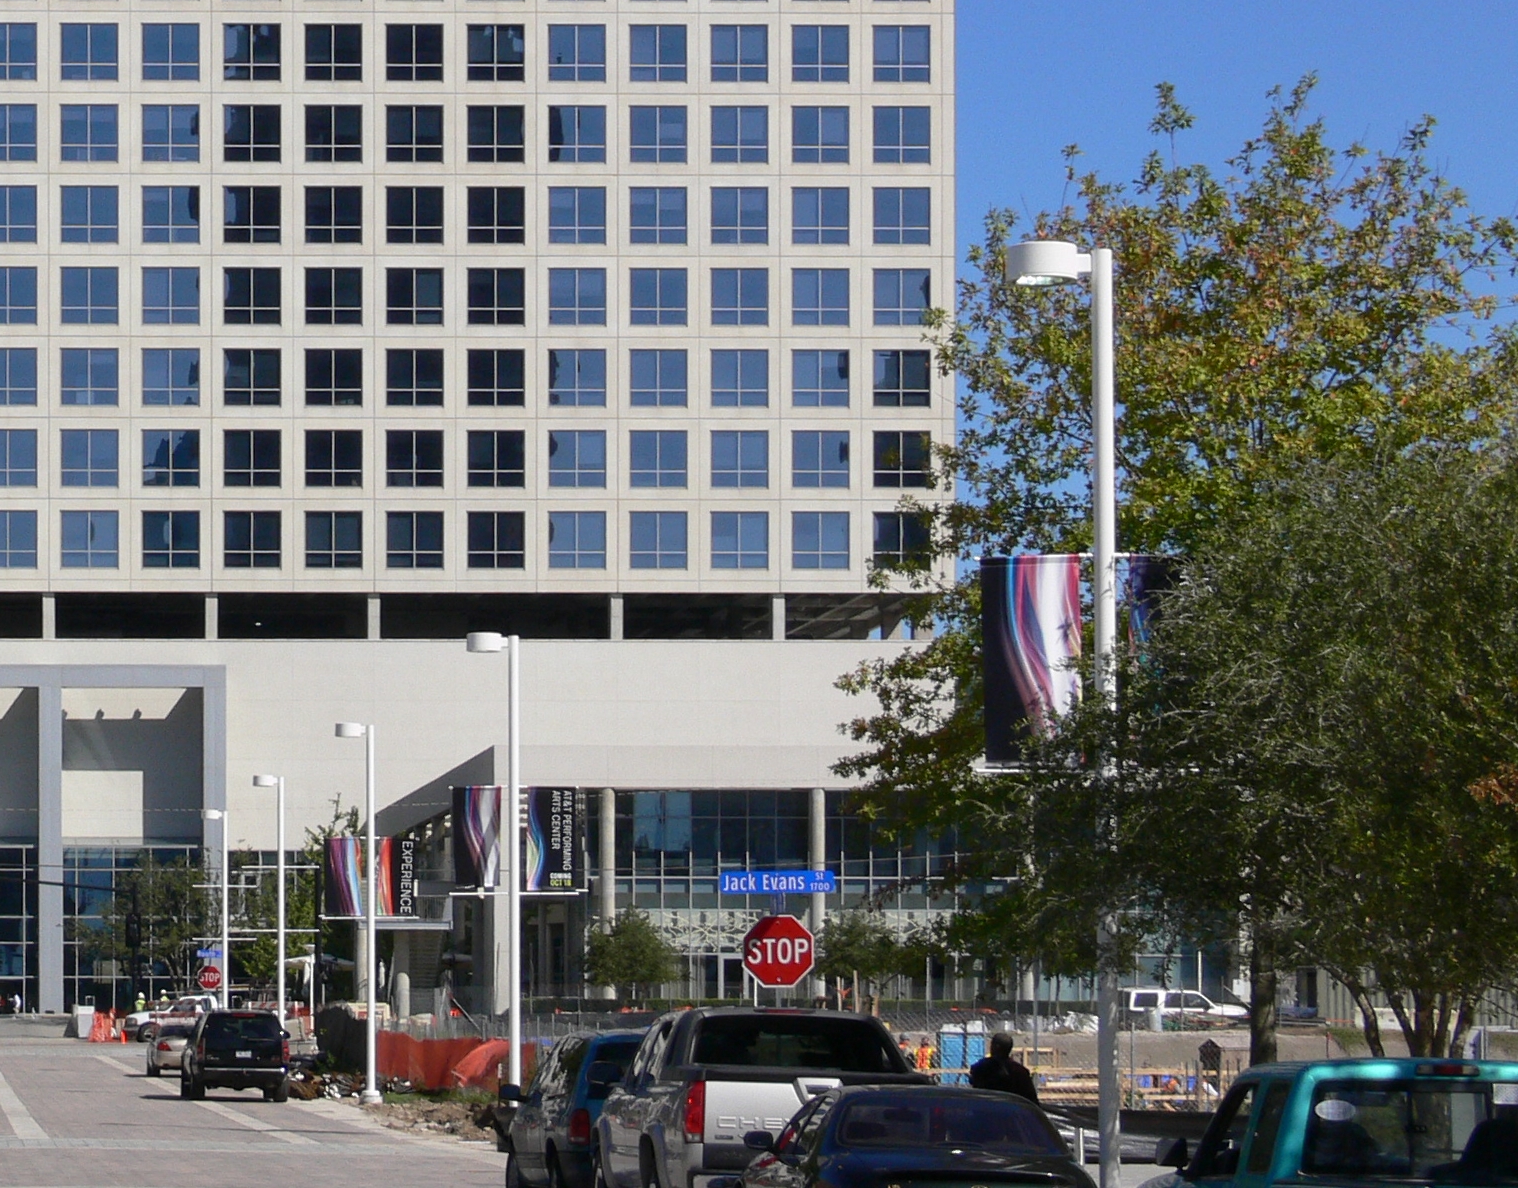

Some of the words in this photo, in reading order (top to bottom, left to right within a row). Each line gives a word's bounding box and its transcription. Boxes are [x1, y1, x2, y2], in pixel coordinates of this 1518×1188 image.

[551, 790, 561, 813] ARTS
[562, 790, 572, 813] AT&T
[551, 814, 561, 850] CENTER
[562, 814, 572, 871] PERFORMING
[400, 841, 414, 914] EXPERIENCE
[549, 879, 562, 887] OCT
[723, 874, 756, 891] Jack
[762, 874, 805, 891] Evans
[815, 872, 824, 880] St
[810, 882, 830, 891] 1700
[747, 938, 809, 965] STOP
[199, 972, 220, 983] STOP
